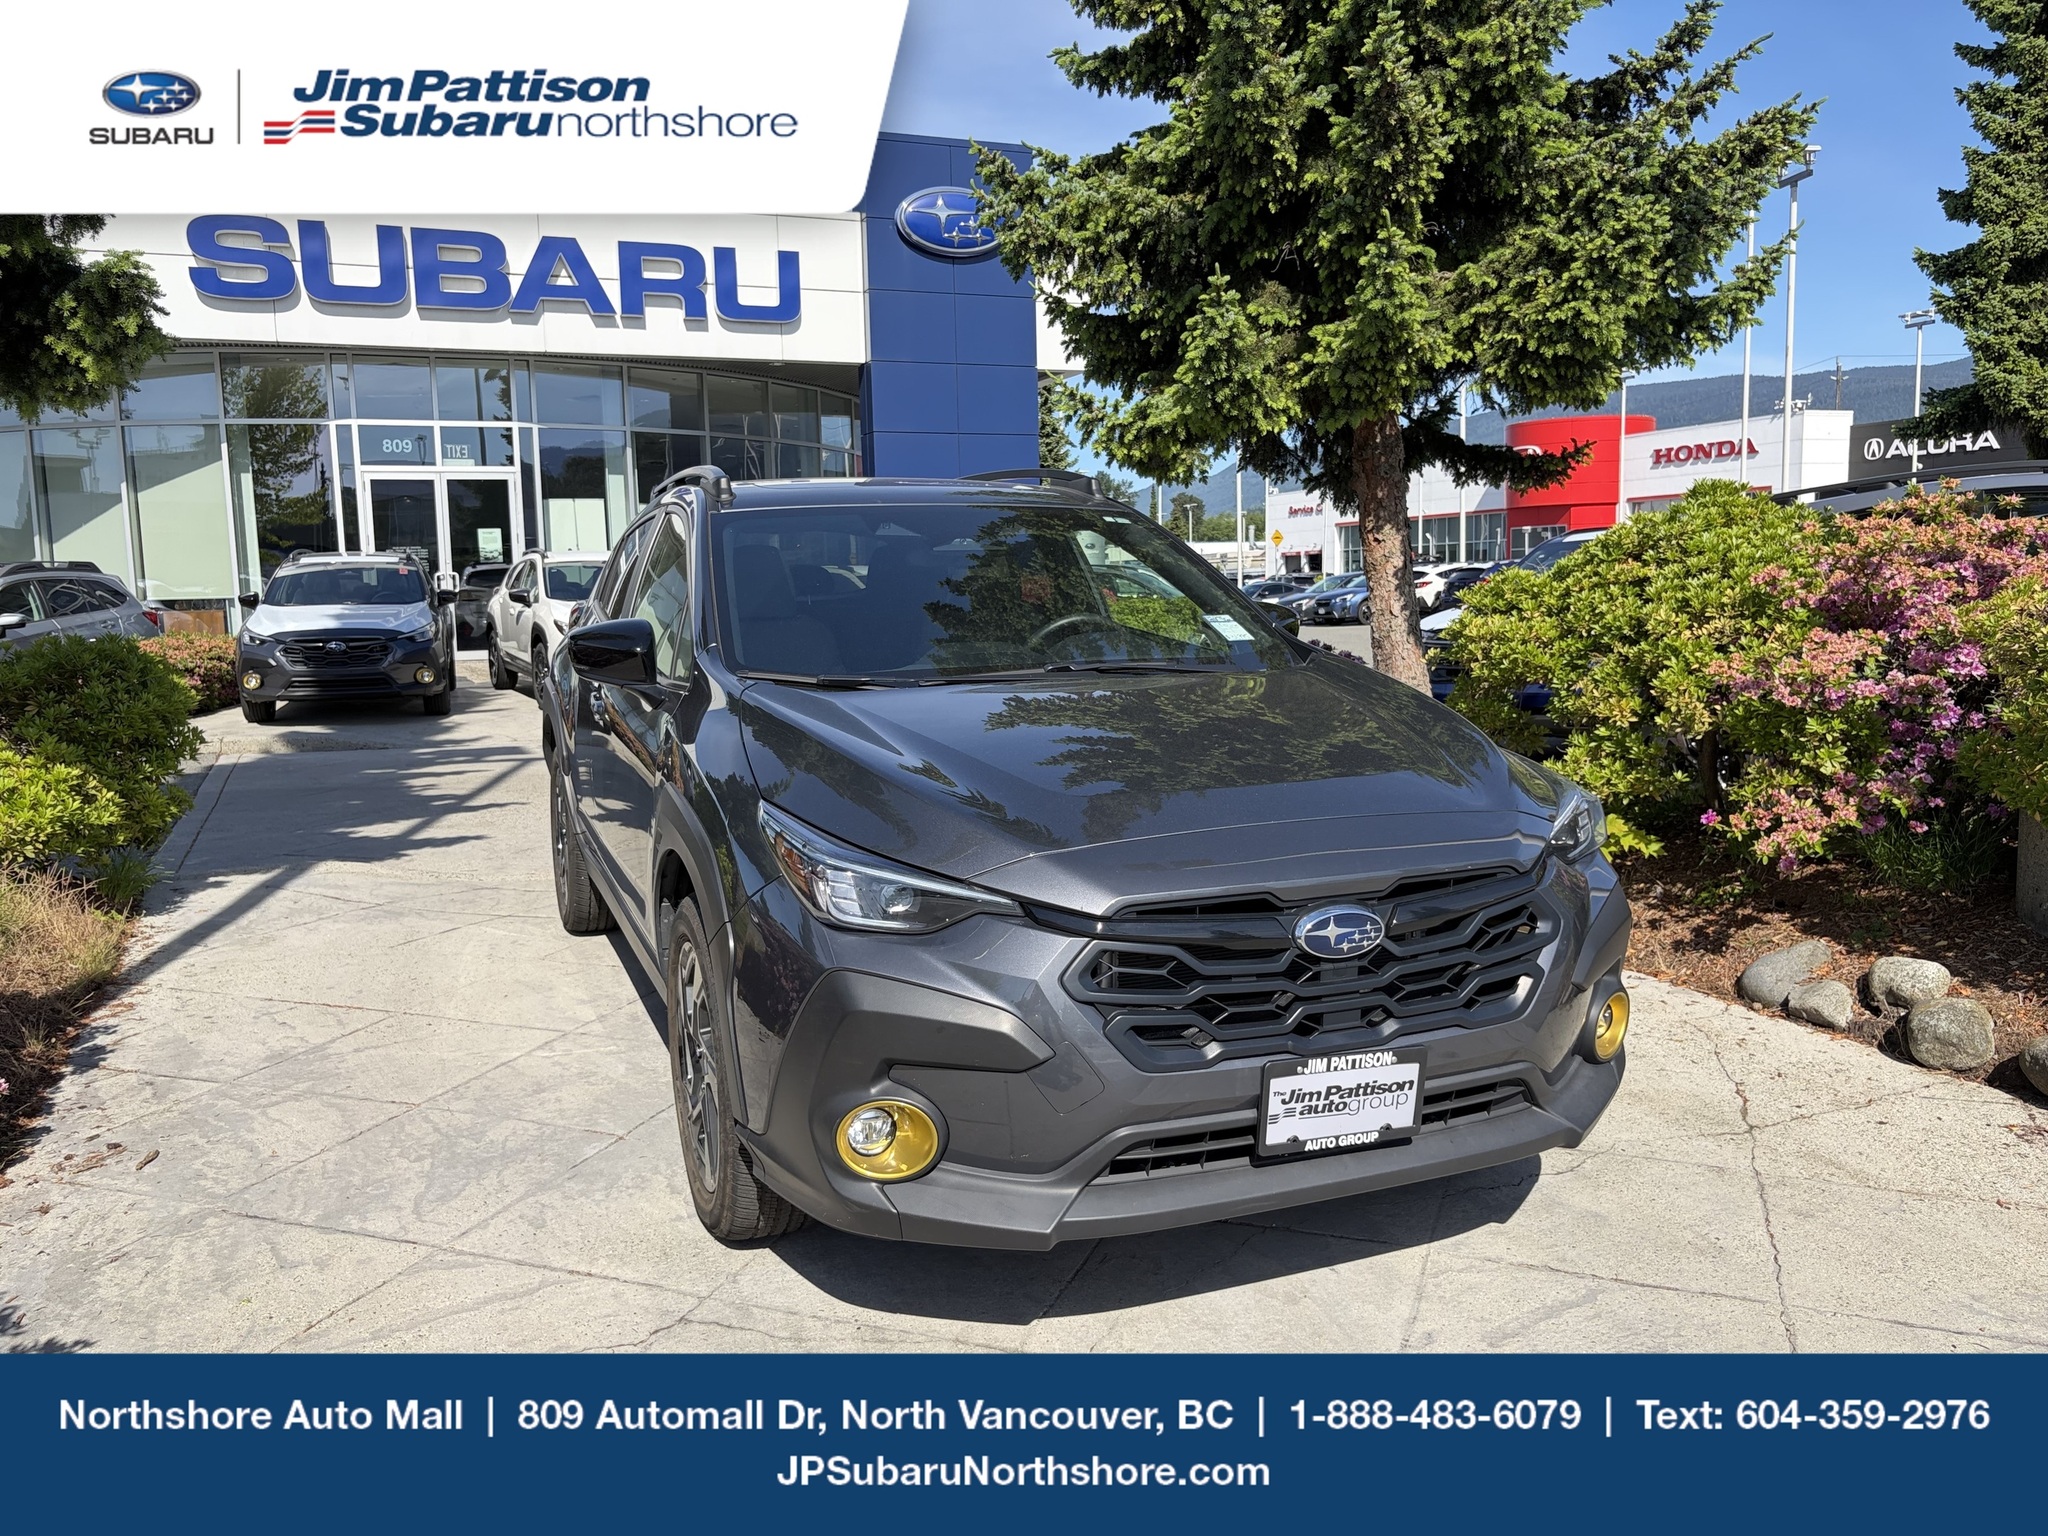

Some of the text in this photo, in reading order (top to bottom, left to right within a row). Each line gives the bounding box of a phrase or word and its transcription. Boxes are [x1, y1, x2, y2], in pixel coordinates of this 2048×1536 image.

[186, 213, 802, 325] SUBARU
[382, 439, 413, 453] 809
[1652, 437, 1759, 465] HONDA
[1289, 504, 1314, 515] Service
[1304, 1051, 1393, 1075] JIM PATTISON
[1281, 1088, 1322, 1106] Jim
[1323, 1079, 1415, 1101] Pattison
[1304, 1131, 1379, 1152] AUTO GROUP
